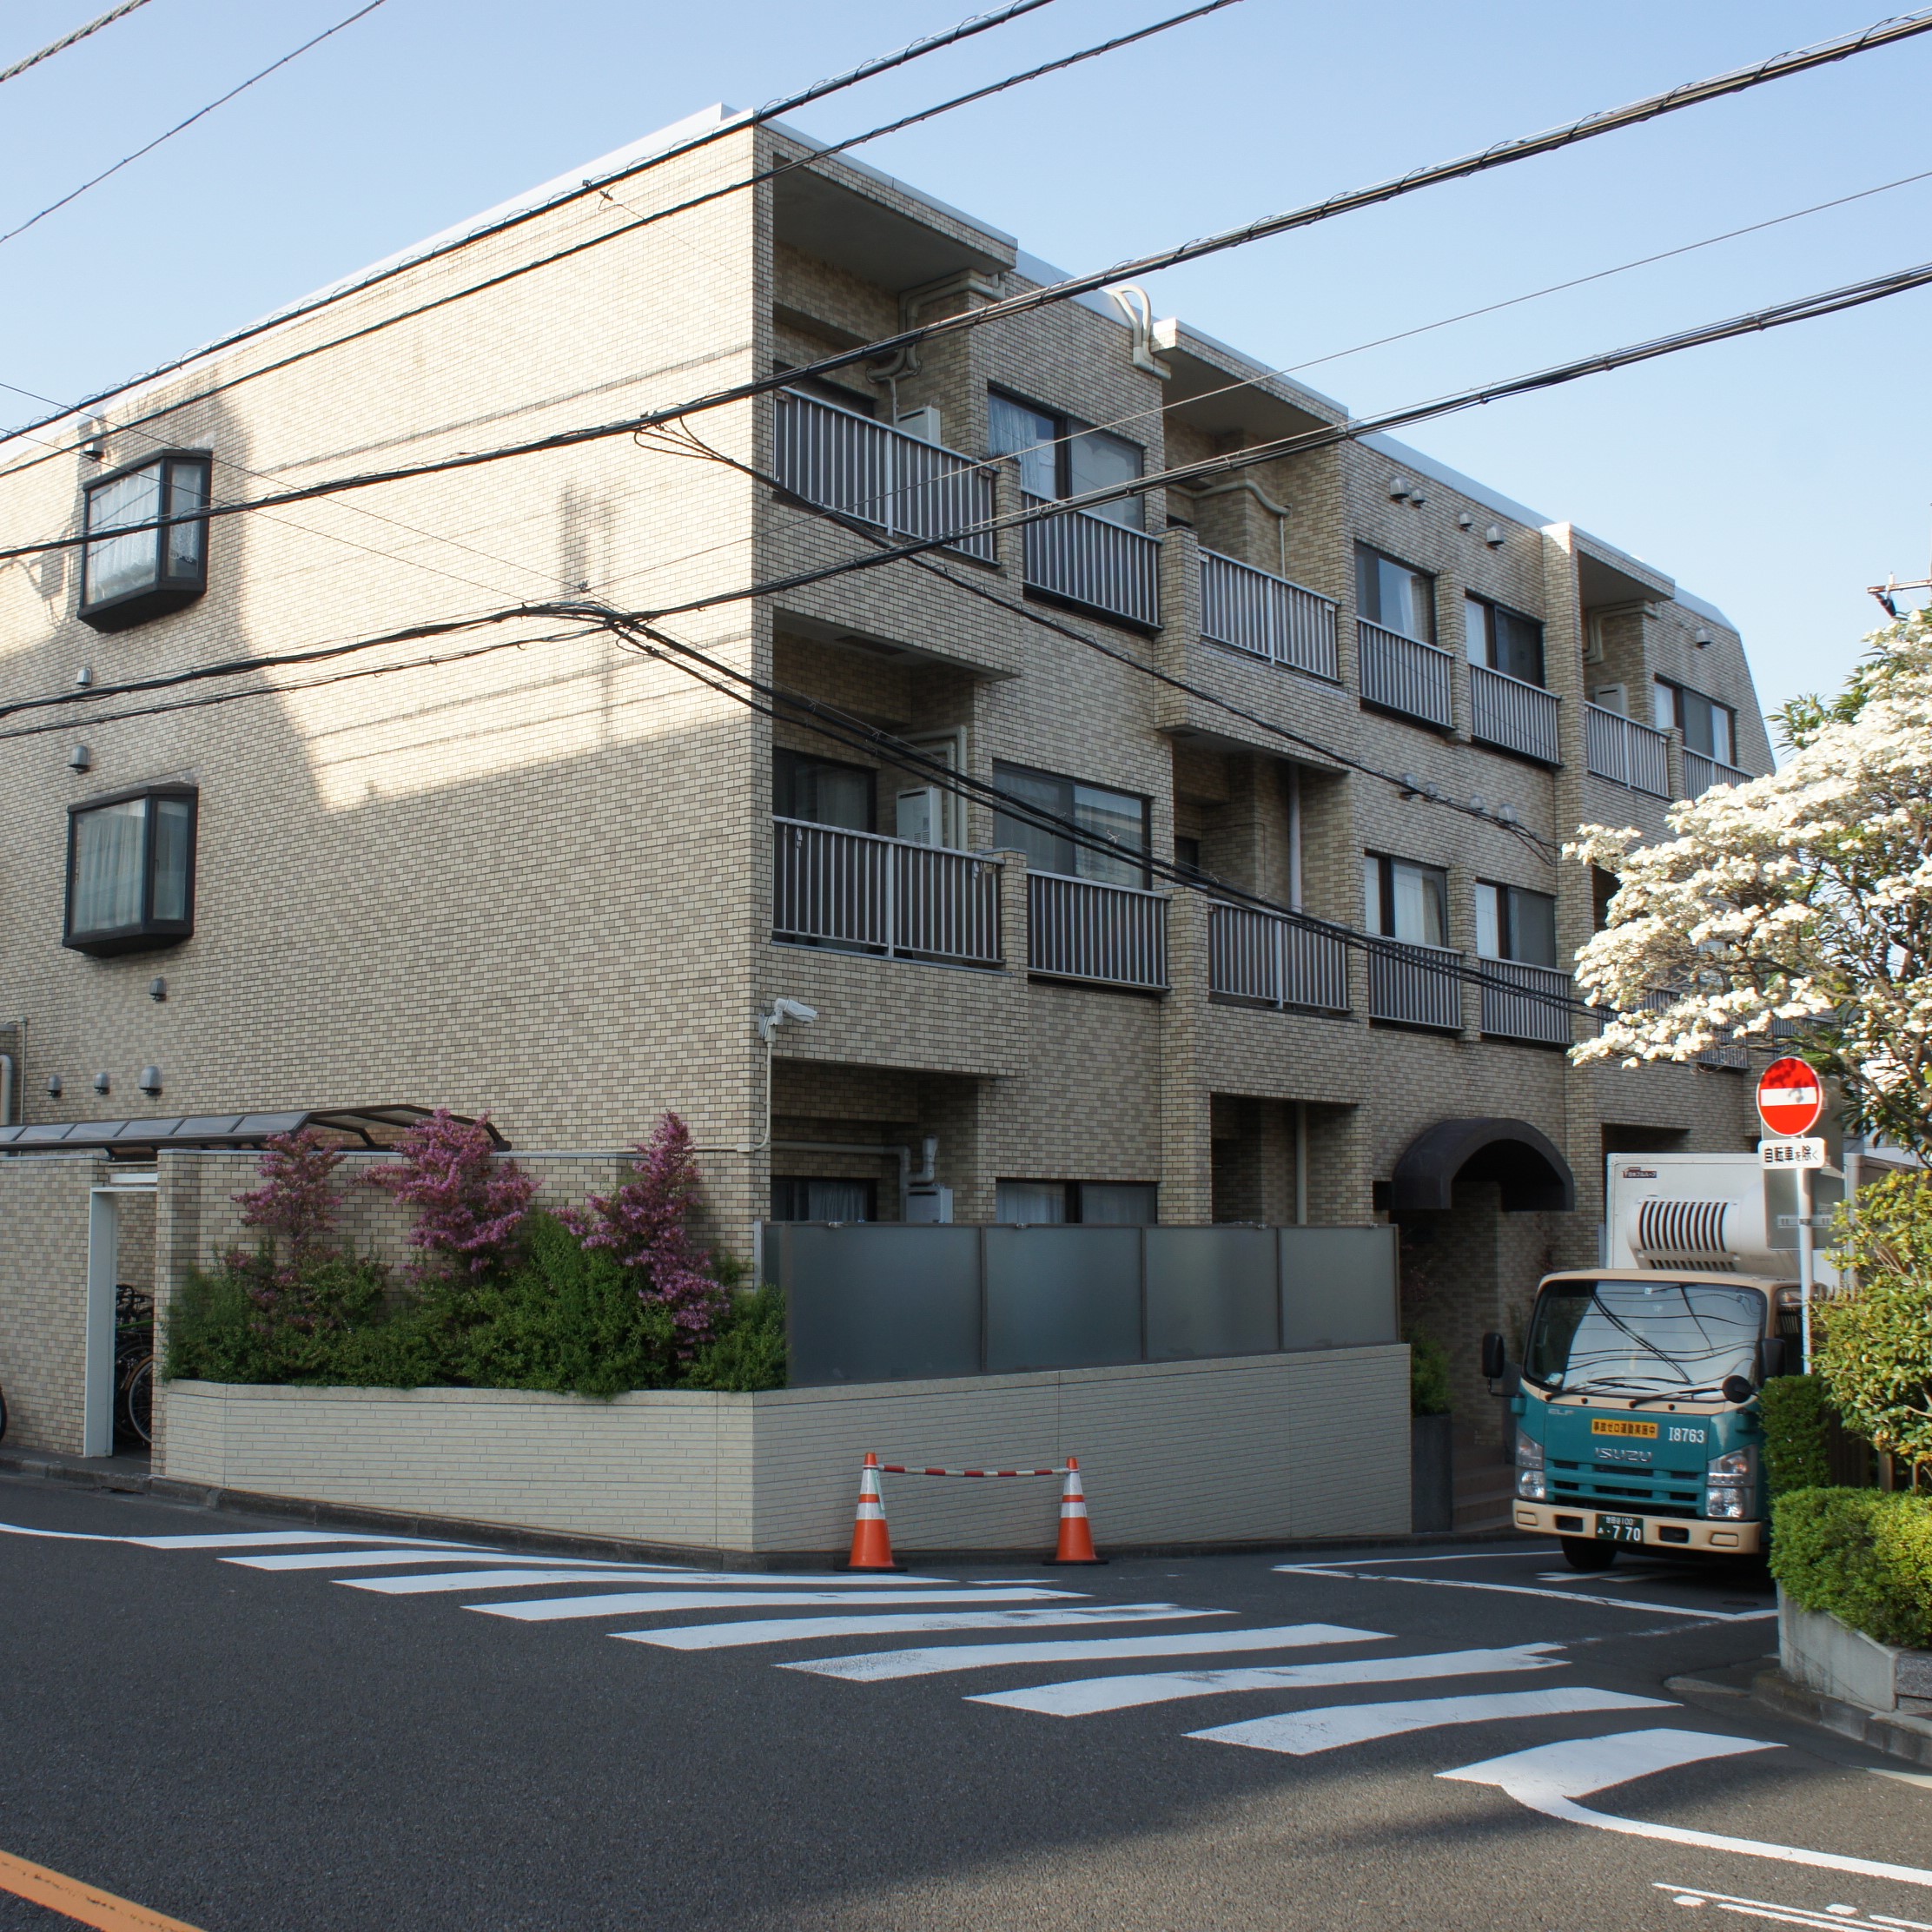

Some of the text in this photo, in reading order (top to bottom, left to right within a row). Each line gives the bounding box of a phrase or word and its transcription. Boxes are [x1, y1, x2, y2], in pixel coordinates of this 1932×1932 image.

[1764, 1145, 1818, 1163] 自転車を除く
[1595, 1447, 1652, 1462] ISUZU
